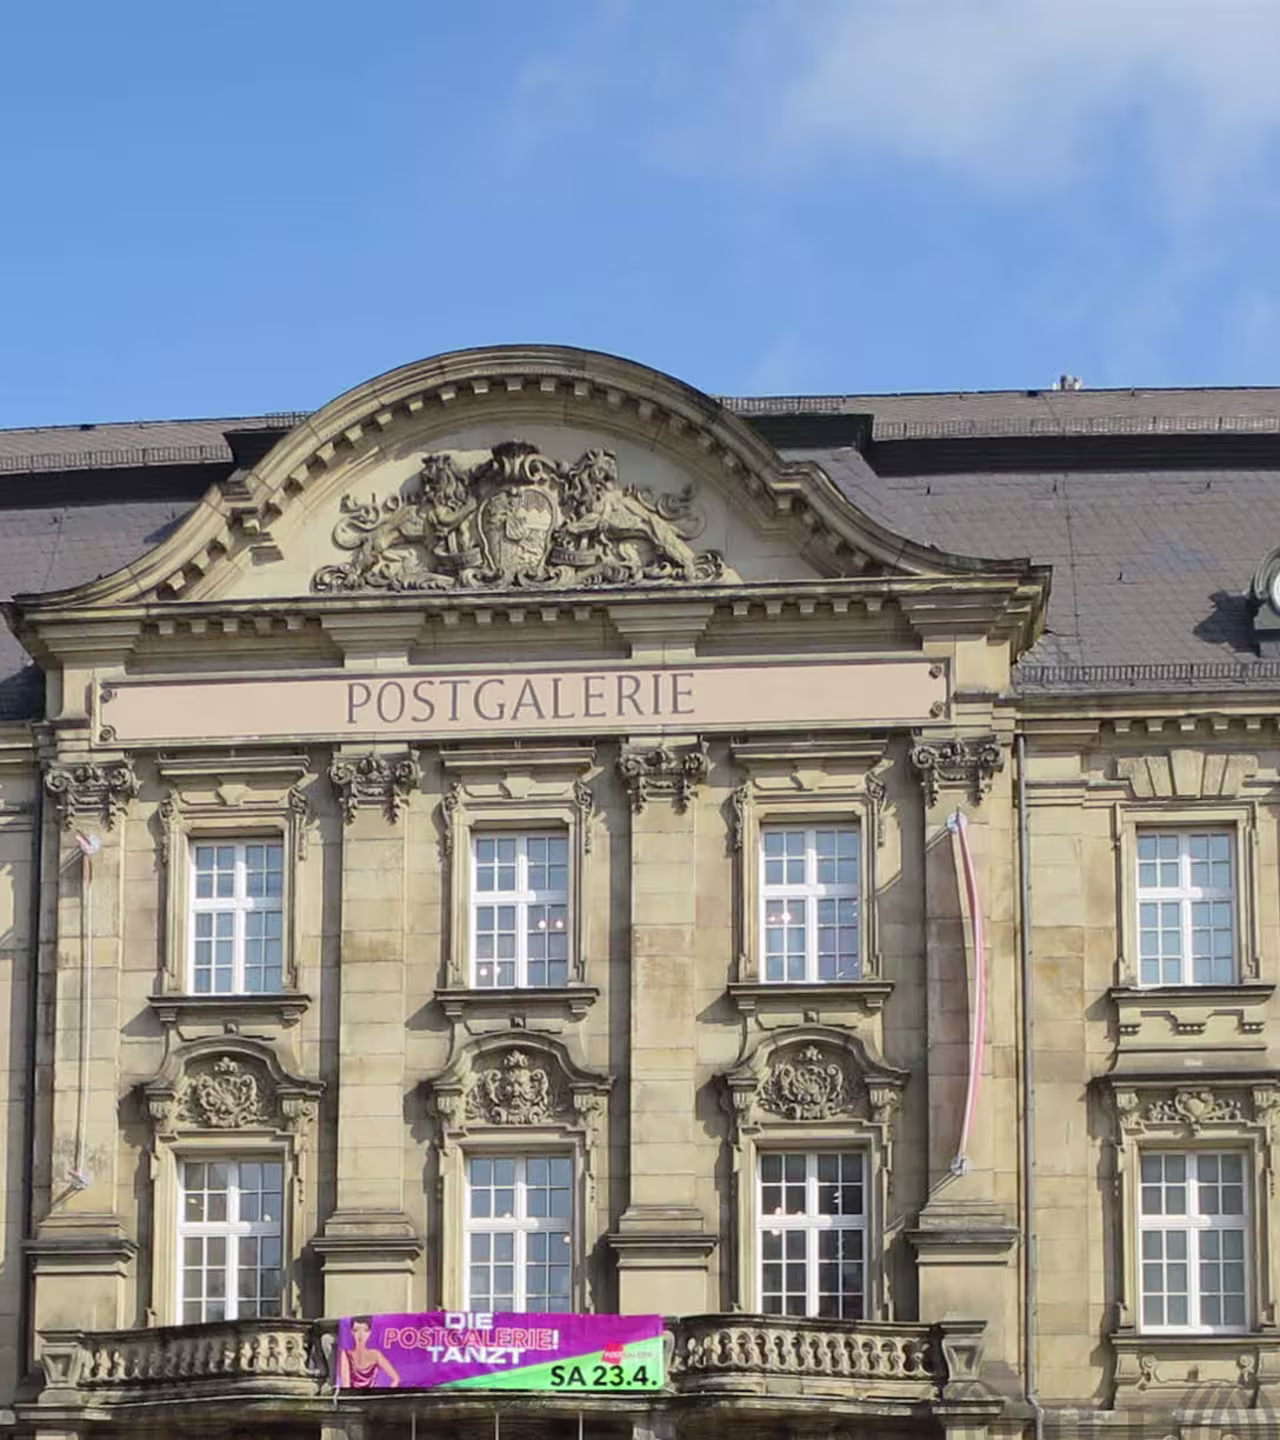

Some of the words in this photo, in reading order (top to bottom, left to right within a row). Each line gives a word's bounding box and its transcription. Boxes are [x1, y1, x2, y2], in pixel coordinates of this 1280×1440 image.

[346, 673, 696, 724] POSTGALERIE
[445, 1312, 494, 1330] DIE
[384, 1326, 560, 1351] POSTGALERIE!
[426, 1346, 526, 1365] TANZT
[550, 1365, 587, 1387] SA
[593, 1365, 657, 1387] 23.4.
